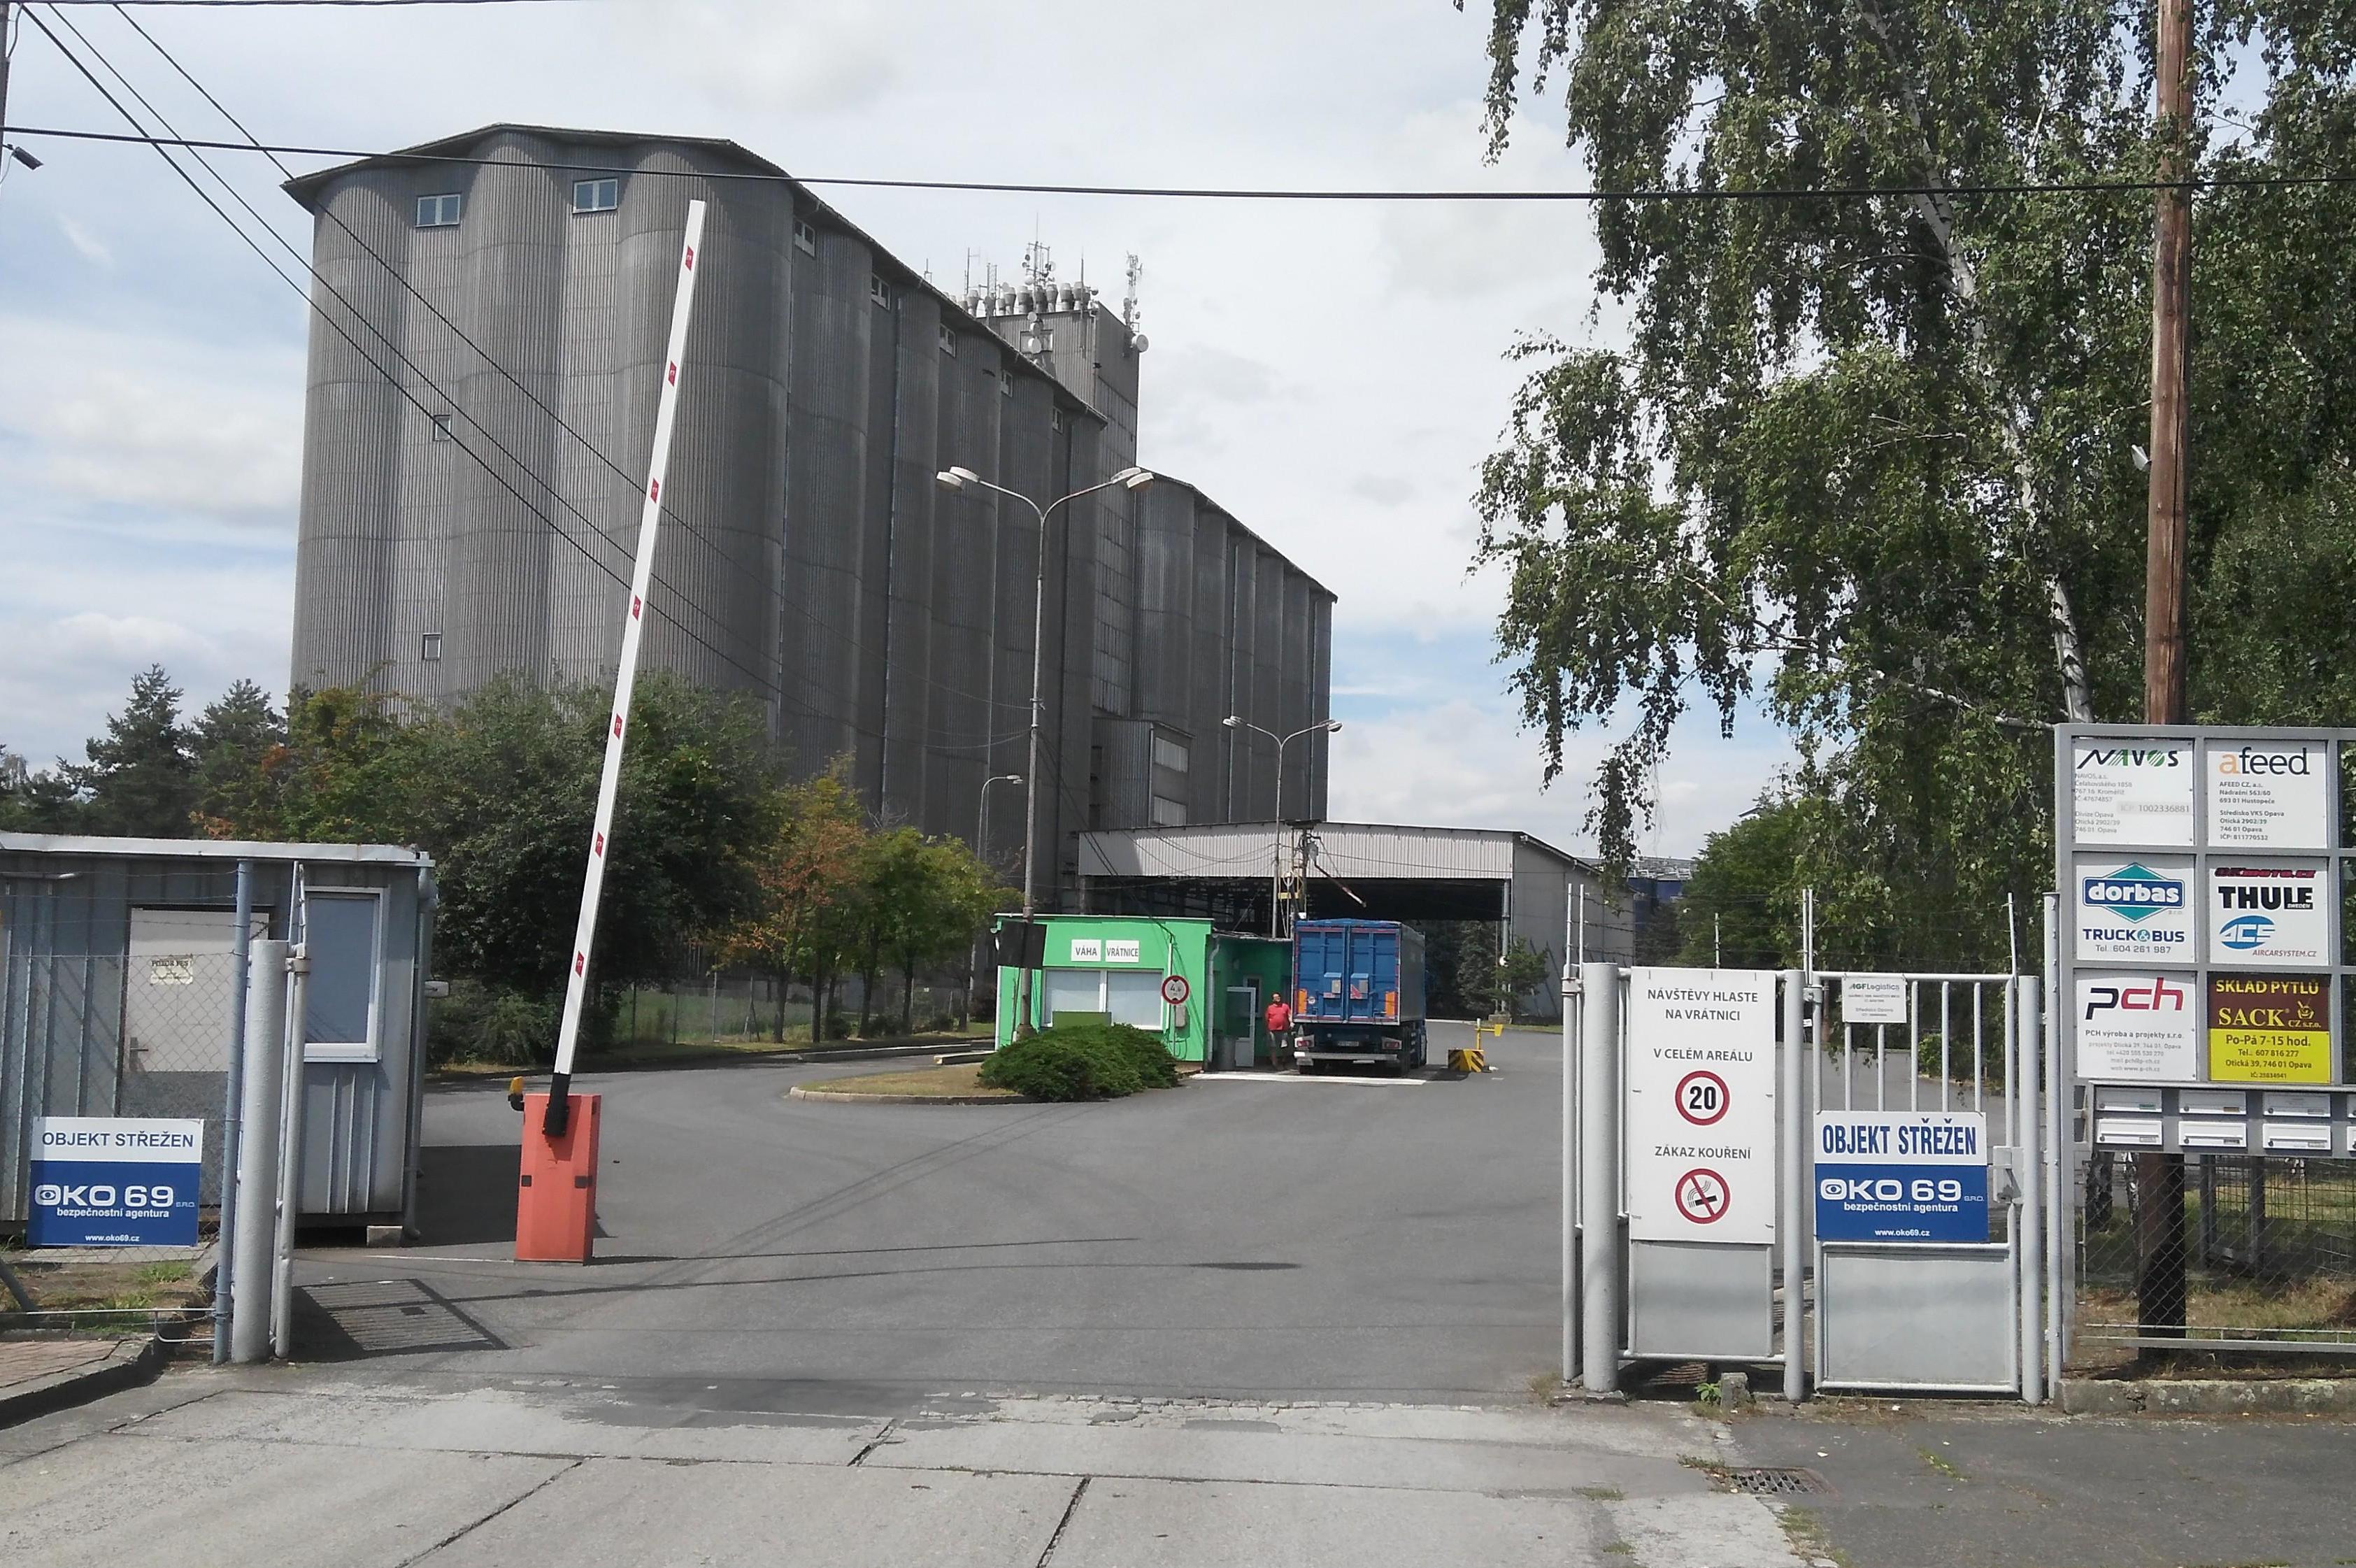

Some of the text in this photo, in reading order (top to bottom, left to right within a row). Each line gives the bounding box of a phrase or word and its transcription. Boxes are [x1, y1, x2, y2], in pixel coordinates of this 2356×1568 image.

[2077, 750, 2178, 769] NAVOS
[2219, 746, 2310, 775] afeed
[2139, 804, 2189, 813] 1002336881
[2089, 883, 2179, 903] dorbas
[2218, 886, 2313, 910] THULE
[1076, 946, 1097, 956] VÁHA
[1106, 946, 1138, 957] VRÁTNICE
[1648, 988, 1758, 1002] NÁVŠTĚVY HLASTE
[2216, 980, 2319, 995] SKLAD PYTLŮ
[2085, 977, 2184, 1020] pch
[1666, 1008, 1740, 1020] NA VRÁTNICI
[2219, 1007, 2285, 1027] SACK
[2226, 1034, 2311, 1046] Po-Pá 7-15 hod.
[1654, 1048, 1752, 1062] V CELÉM AREÁLU
[1689, 1086, 1716, 1110] 20
[43, 1131, 193, 1147] OBJEKT STŘEŽEN
[1823, 1118, 1976, 1155] OBJEKT STŘEŽEN
[1655, 1144, 1751, 1159] ZÁKAZ KOUŘENÍ
[35, 1185, 115, 1206] OKO
[124, 1185, 173, 1207] 69
[1820, 1179, 1902, 1201] OKO
[1911, 1179, 1962, 1202] 69
[57, 1208, 169, 1219] bezpečnostní agentura
[1844, 1202, 1958, 1213] bezpečnostní agentura
